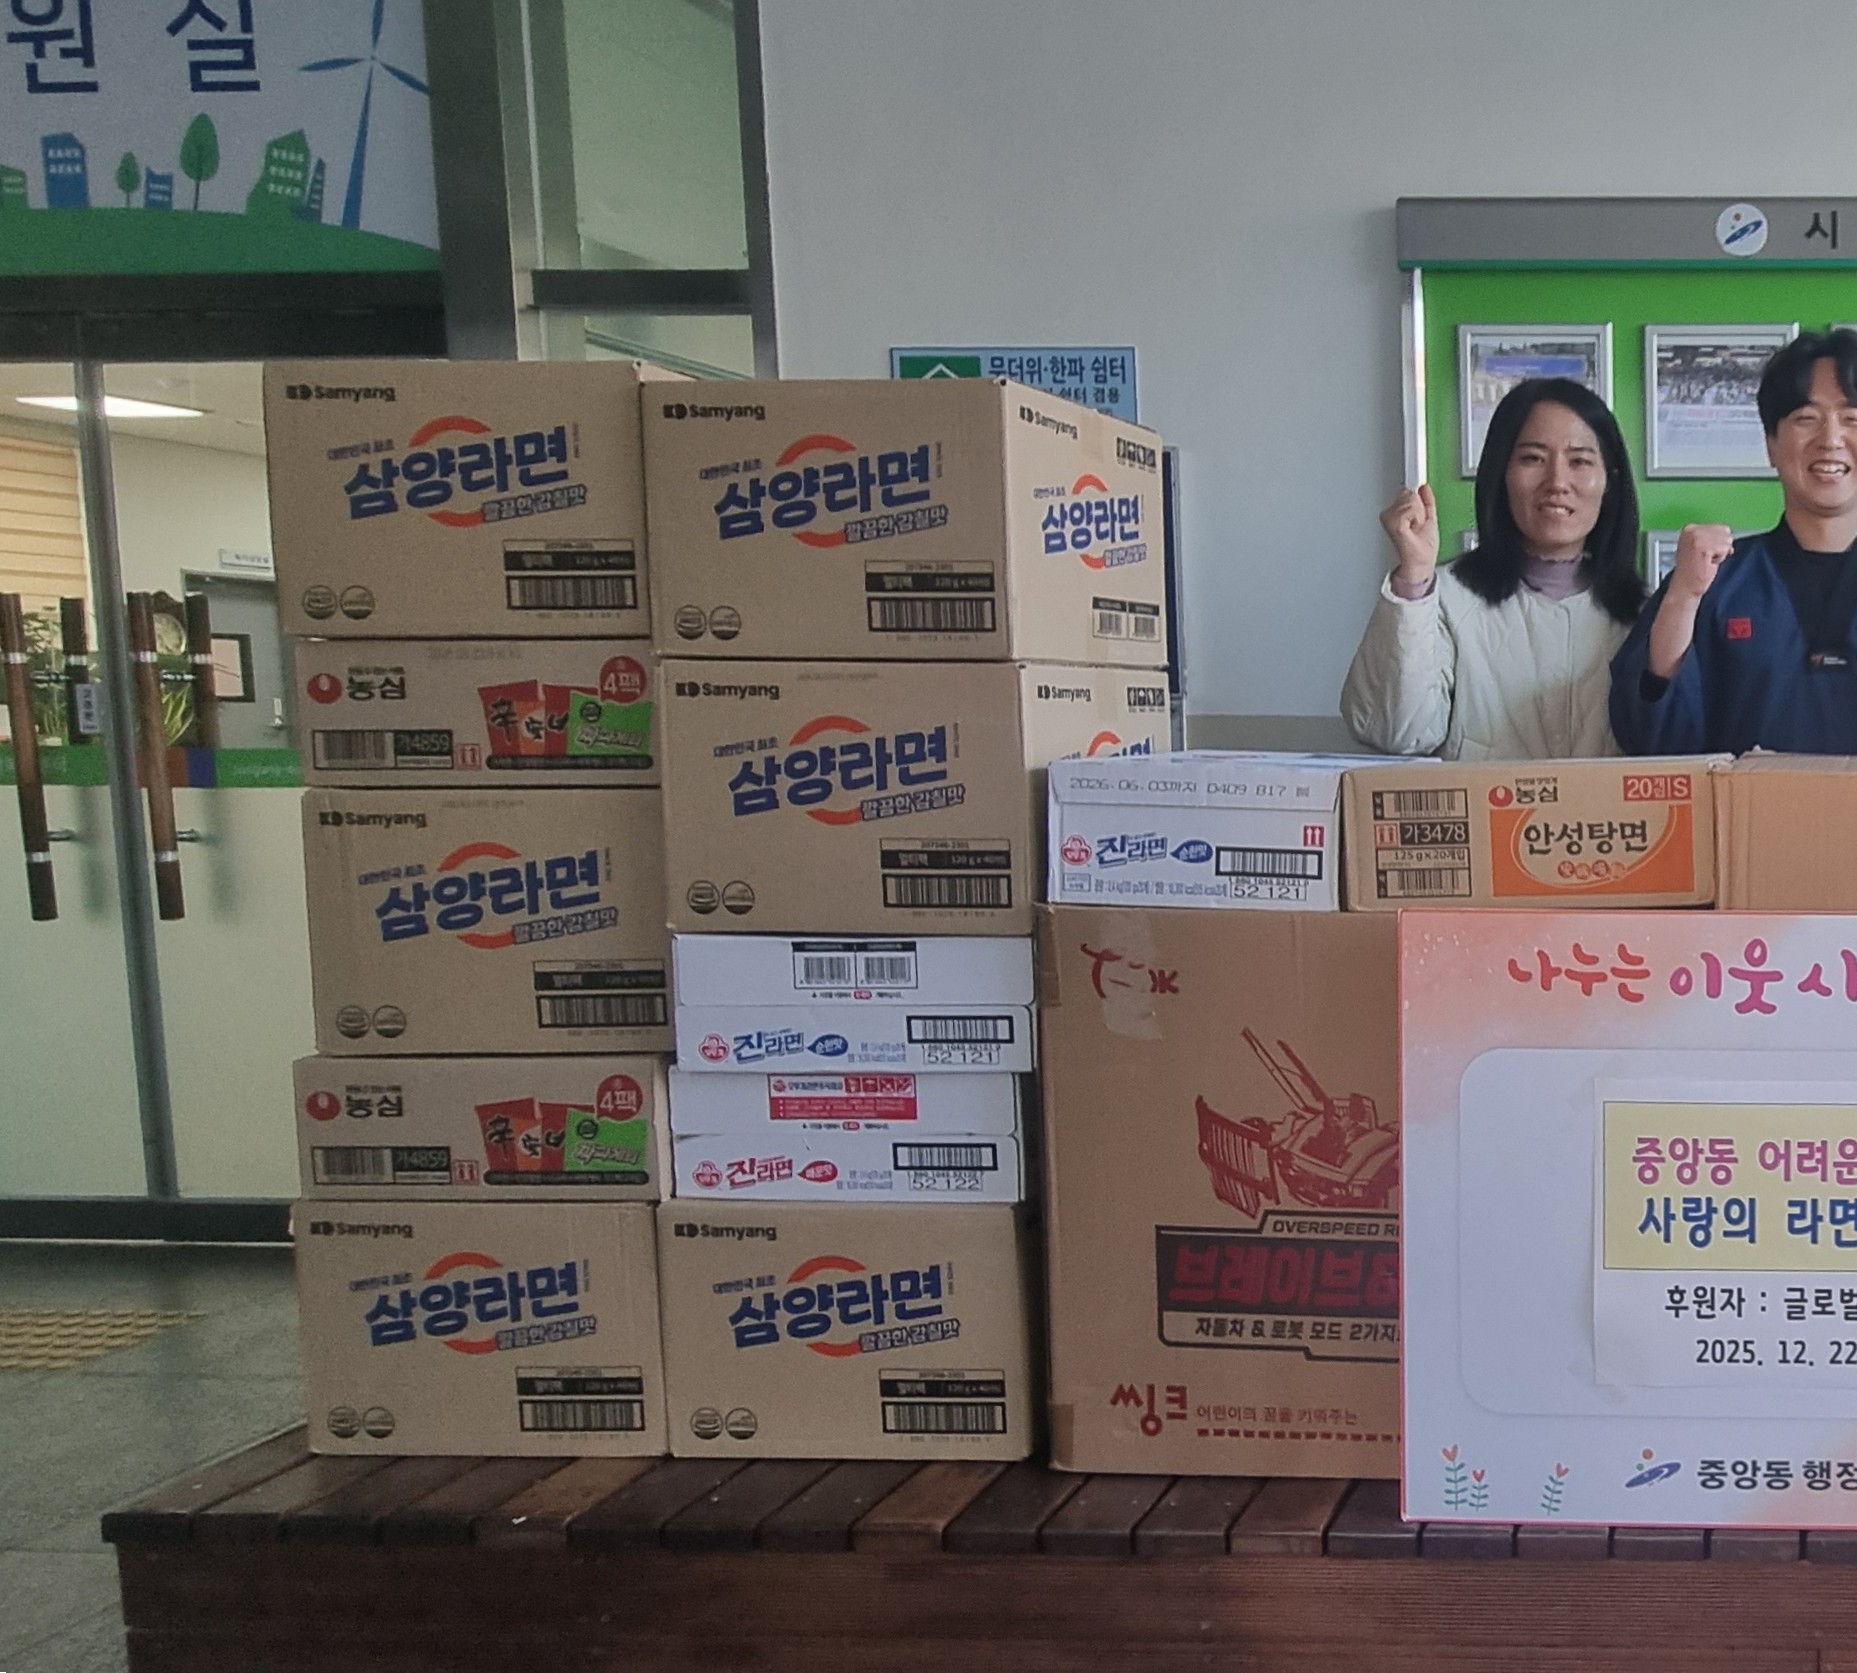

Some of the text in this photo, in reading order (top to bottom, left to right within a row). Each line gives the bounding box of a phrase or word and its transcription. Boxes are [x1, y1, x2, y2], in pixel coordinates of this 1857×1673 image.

[1090, 356, 1127, 384] 쉼터
[314, 385, 396, 402] Samyang
[1093, 387, 1120, 403] 겸용
[689, 403, 766, 420] Samyang
[1034, 411, 1078, 440] Samyang
[343, 425, 569, 520] 삼양라면
[713, 443, 931, 541] 삼양라면
[1041, 493, 1141, 554] 삼양라면
[346, 675, 406, 701] 농심
[602, 671, 643, 696] 4팩
[702, 682, 779, 700] Samyang
[1051, 685, 1091, 702] Samyang
[728, 725, 948, 818] 삼양라면
[1514, 785, 1559, 804] 농심
[1673, 777, 1689, 799] S
[345, 812, 427, 829] Samyang
[1403, 823, 1466, 844] 가3478
[1096, 833, 1168, 868] 진라면
[1523, 819, 1649, 856] 안성탕면
[375, 850, 601, 942] 삼양라면
[1233, 885, 1258, 899] 52
[1264, 886, 1301, 900] 121
[1507, 942, 1651, 1003] 나누는
[1668, 937, 1784, 1015] 이웃
[732, 1030, 805, 1065] 진라면
[926, 1051, 995, 1064] 52 121
[345, 1095, 404, 1118] 농심
[600, 1090, 637, 1112] 4팩
[725, 1157, 794, 1190] 진라면
[1631, 1136, 1740, 1187] 중앙동
[911, 1178, 981, 1191] 52 122
[336, 1222, 413, 1239] Samyang
[700, 1224, 777, 1241] Samyang
[1272, 1219, 1380, 1237] OVERSPEED
[1637, 1195, 1758, 1249] 사랑의
[364, 1261, 580, 1347] 삼양라면
[728, 1264, 943, 1348] 삼양라면
[1664, 1284, 1747, 1320] 후원자
[1195, 1316, 1245, 1338] 자동차
[1251, 1319, 1267, 1338] &
[1270, 1319, 1304, 1339] 로봇
[1309, 1321, 1342, 1340] 모드
[1695, 1338, 1764, 1367] 2025.
[1777, 1339, 1816, 1368] 12.
[1110, 1383, 1188, 1437] 씽크
[1196, 1405, 1359, 1426] 어린이의 꿈을 키워주는
[1697, 1457, 1795, 1493] 중앙동
